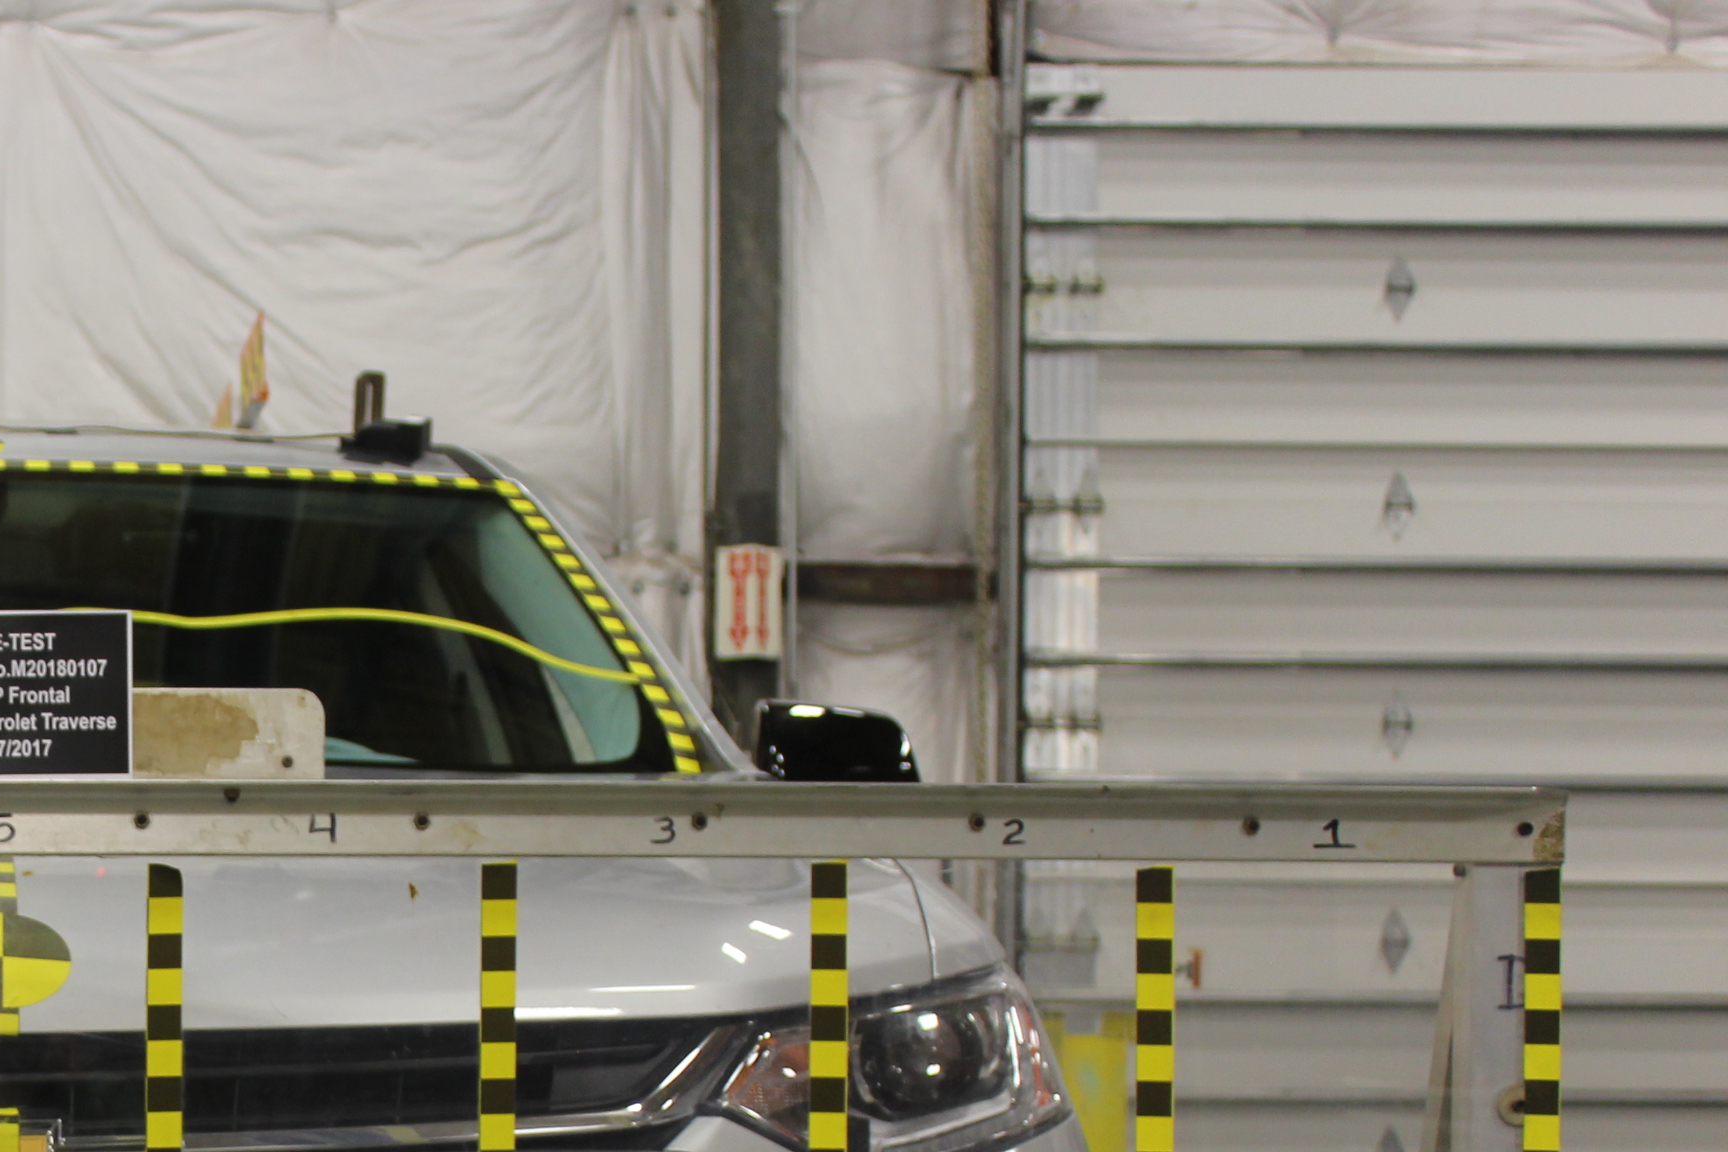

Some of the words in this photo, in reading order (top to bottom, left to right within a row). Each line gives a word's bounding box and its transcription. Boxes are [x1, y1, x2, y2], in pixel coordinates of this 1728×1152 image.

[9, 685, 70, 704] Frontal
[41, 712, 117, 730] Traverse
[308, 811, 338, 843] 4
[650, 815, 677, 845] 3
[1002, 818, 1025, 845] 2
[1313, 817, 1356, 849] 1
